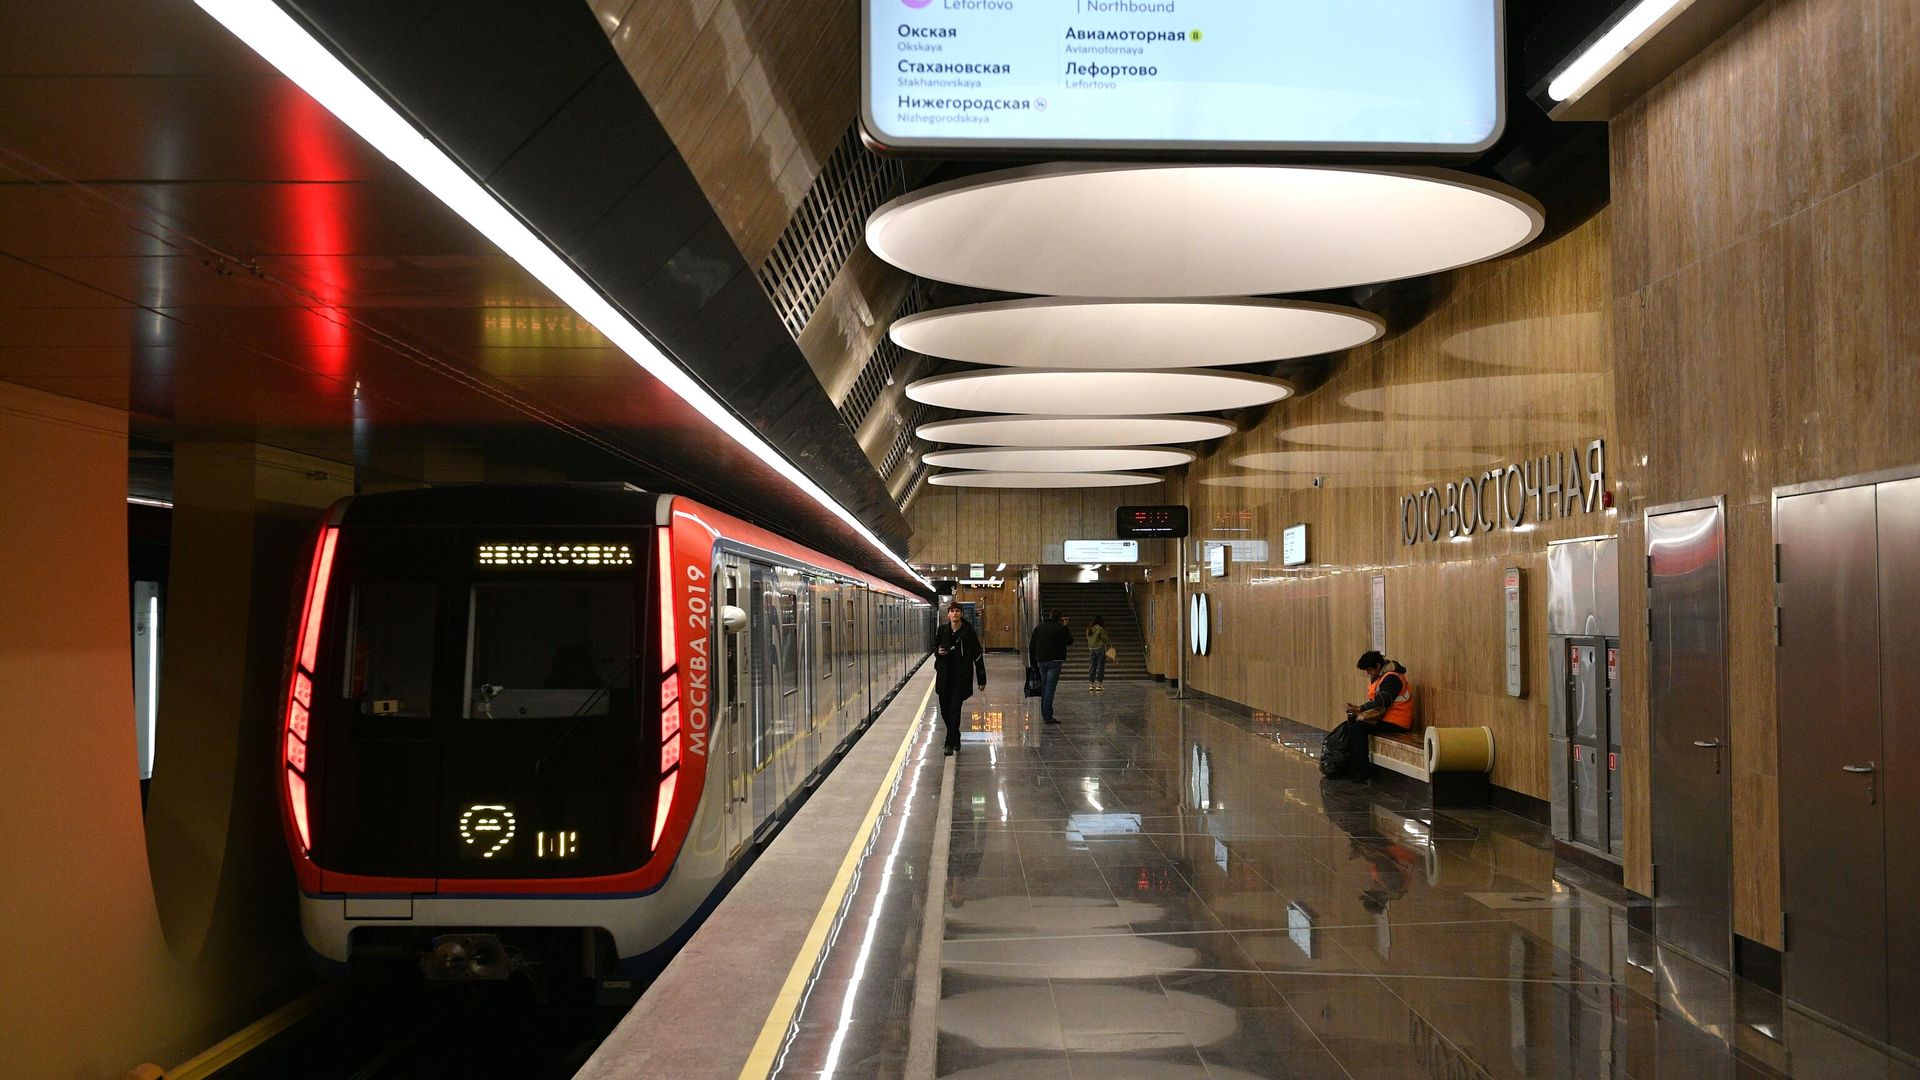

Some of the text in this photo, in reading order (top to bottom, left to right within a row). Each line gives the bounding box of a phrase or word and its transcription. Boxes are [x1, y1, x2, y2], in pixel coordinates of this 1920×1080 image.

[944, 0, 1013, 10] Lefortovo
[1087, 0, 1175, 13] Northbound
[898, 24, 957, 38] Окская
[1065, 27, 1186, 43] Авиамоторная
[897, 42, 943, 52] Okskaya
[1065, 45, 1144, 55] Aviamotornaya
[898, 60, 1010, 74] Стахановская
[1065, 62, 1158, 78] Лефортово
[897, 77, 982, 88] Stakhanovskaya
[1065, 80, 1117, 90] Lefortovo
[898, 96, 1030, 111] Нижегородская
[897, 113, 990, 125] Nizhegorodskaya
[1400, 439, 1605, 546] ЮГО-ВОСТОЧНАЯ
[479, 544, 633, 565] НЕКРАСОВКА
[687, 565, 707, 757] МОСКВА 2019
